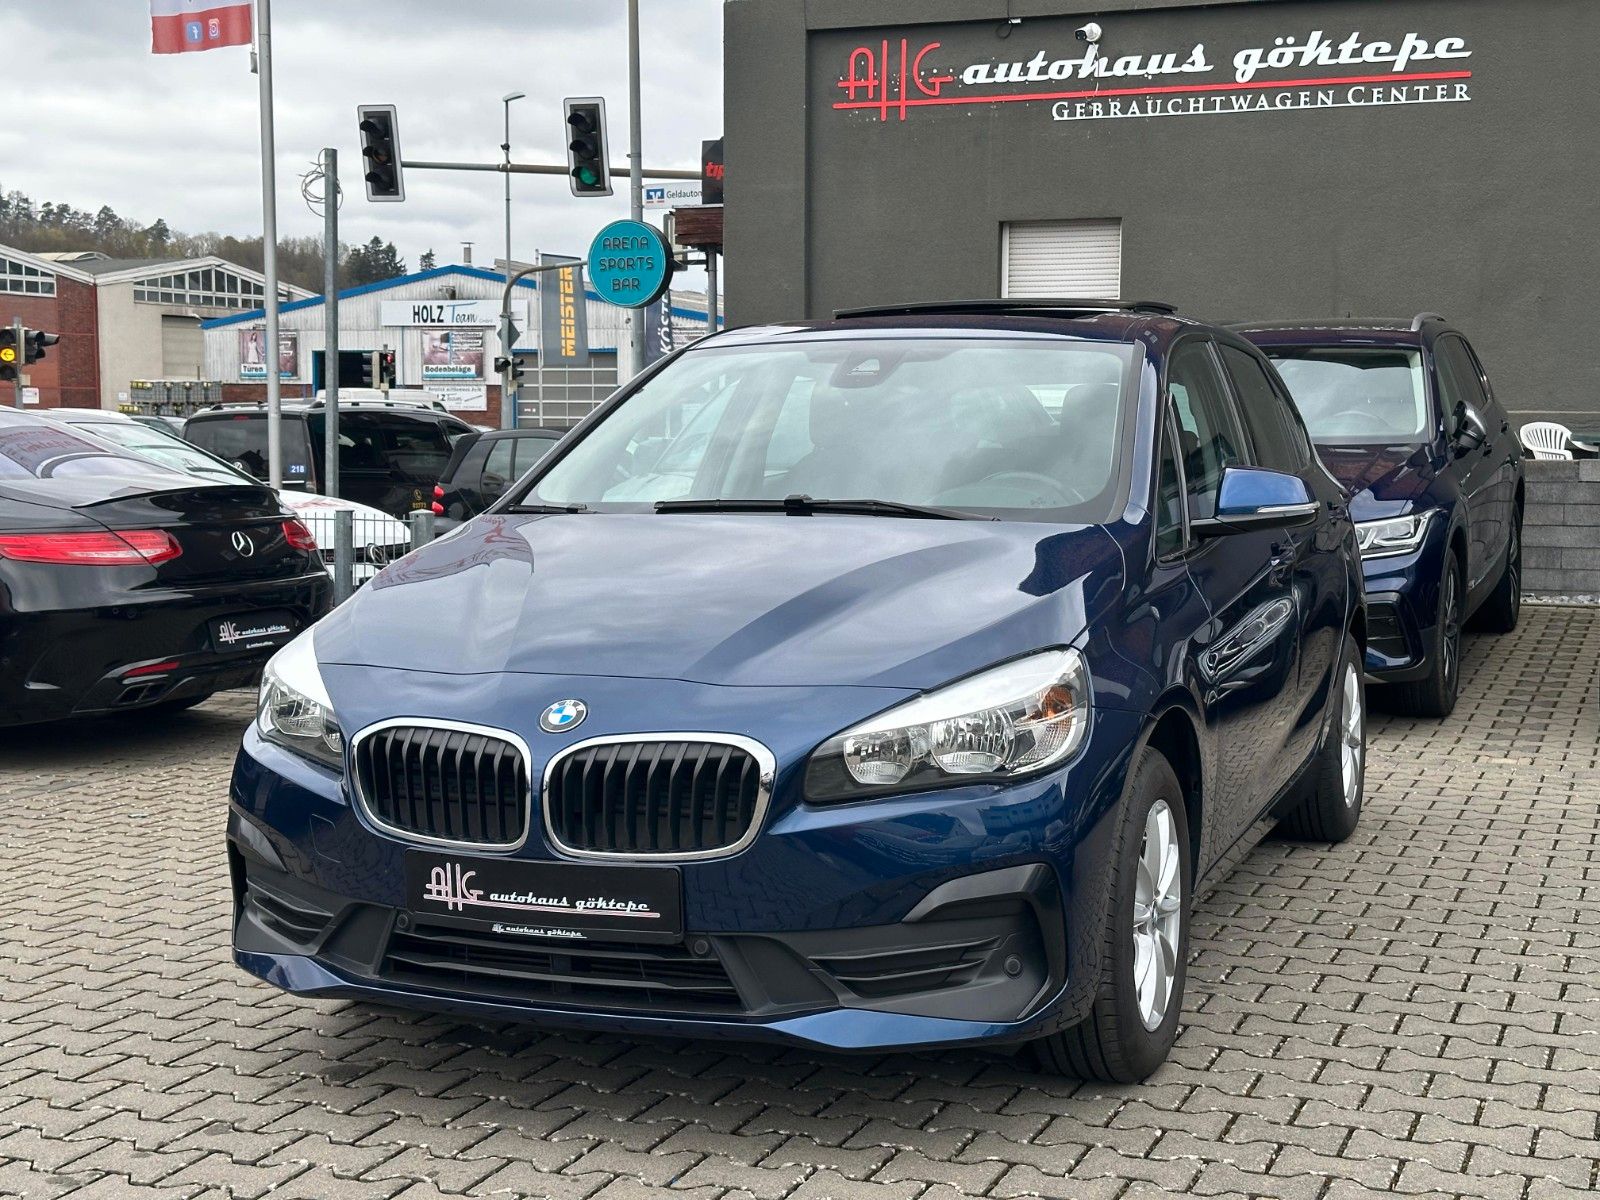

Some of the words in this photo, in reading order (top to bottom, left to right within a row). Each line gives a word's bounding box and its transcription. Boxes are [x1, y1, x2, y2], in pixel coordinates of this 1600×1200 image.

[963, 43, 1214, 85] autohaus
[1232, 30, 1472, 84] göktepe
[1347, 83, 1472, 105] CENTER
[602, 236, 649, 250] ARENA
[599, 256, 655, 272] SPORTS
[612, 278, 641, 292] BAR
[412, 305, 445, 324] HOLZ
[446, 301, 479, 324] Team
[489, 890, 571, 907] autohaus
[575, 896, 651, 913] göktepe
